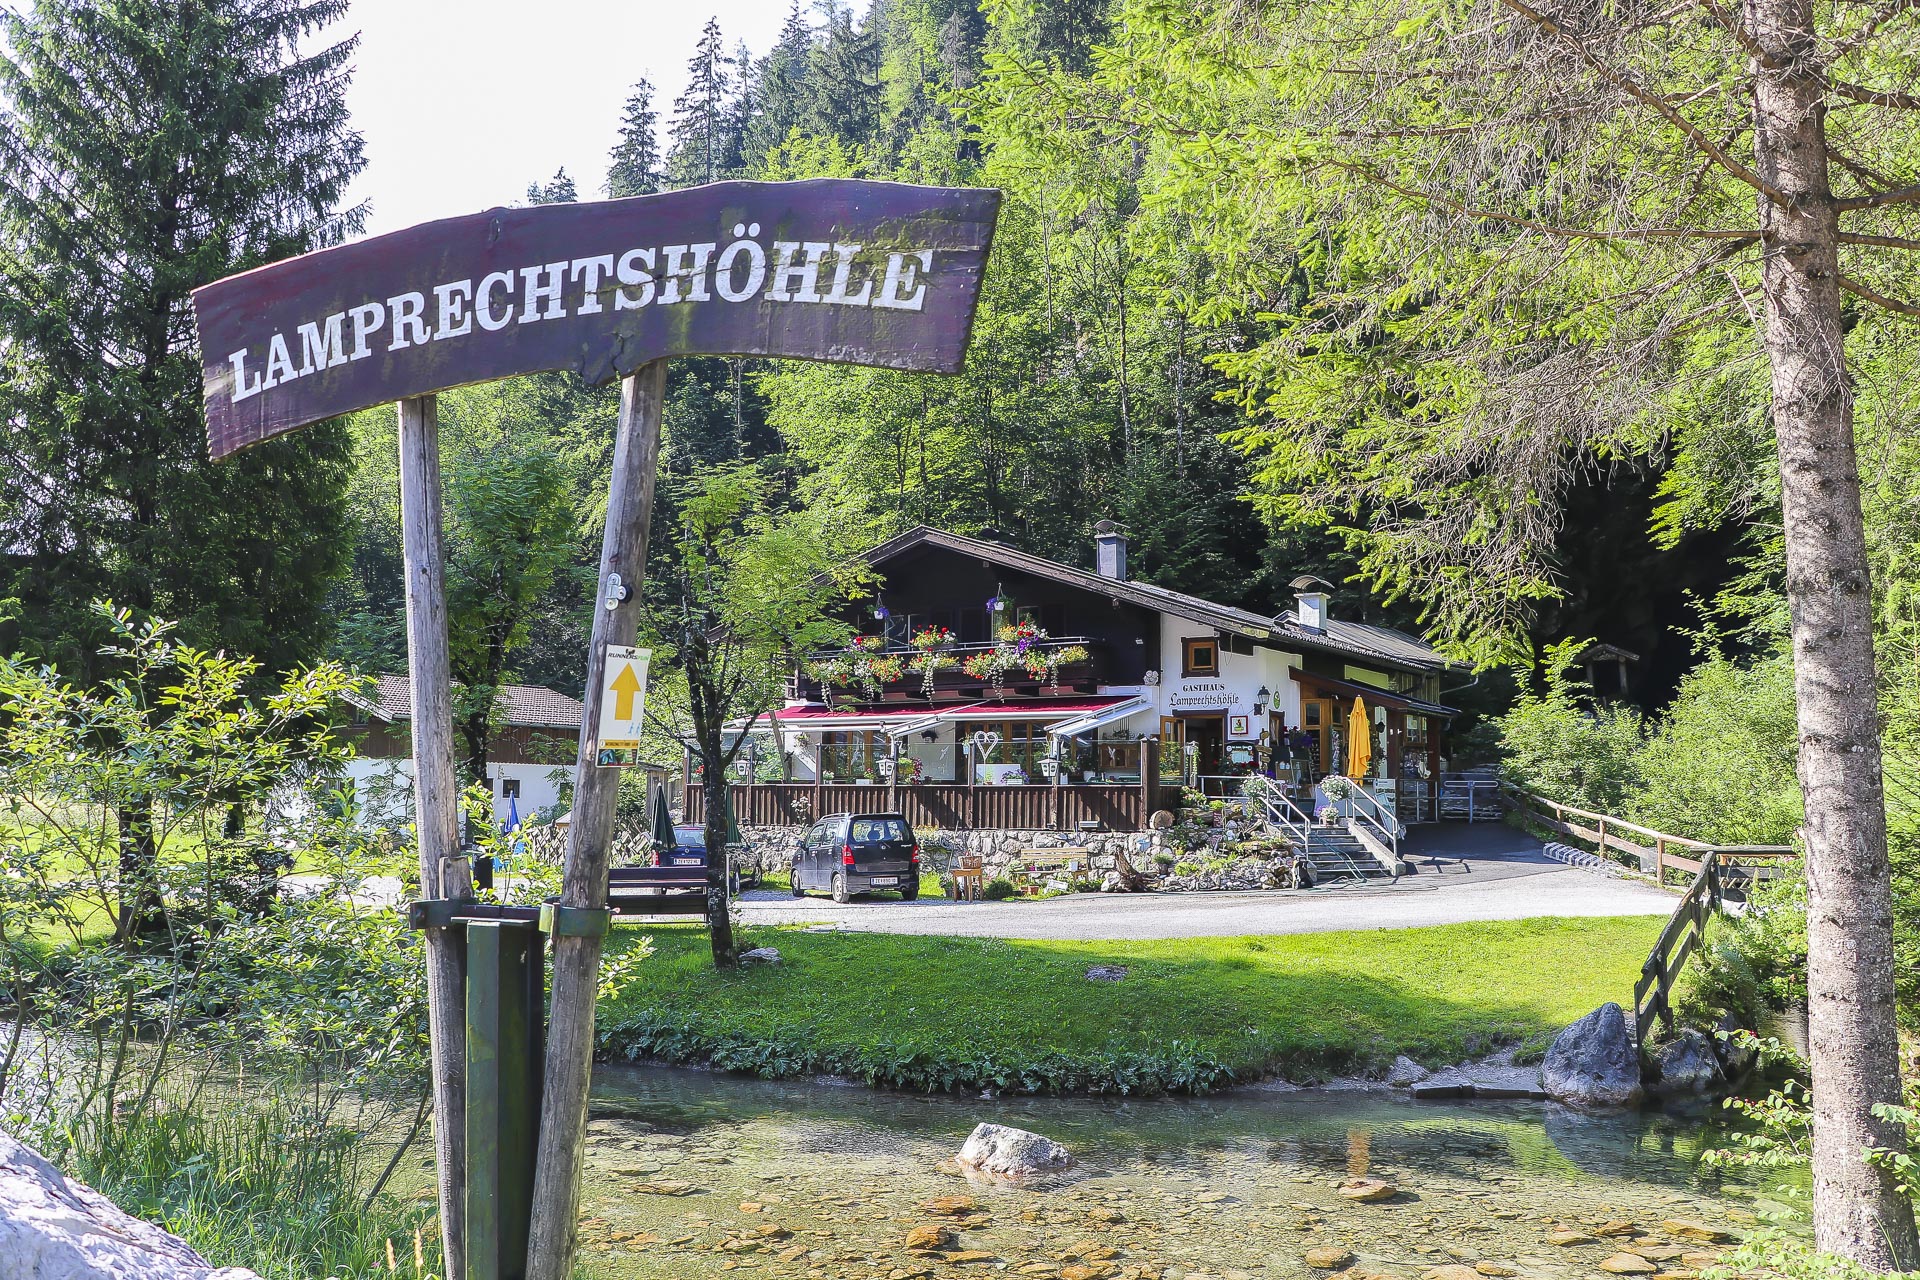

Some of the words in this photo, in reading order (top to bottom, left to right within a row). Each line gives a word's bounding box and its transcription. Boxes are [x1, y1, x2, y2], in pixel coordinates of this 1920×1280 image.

[228, 222, 933, 403] LAMPRECHTSHÖHLE
[1182, 683, 1225, 692] GASTHAUS
[1169, 692, 1240, 708] Lamprechtshöhle
